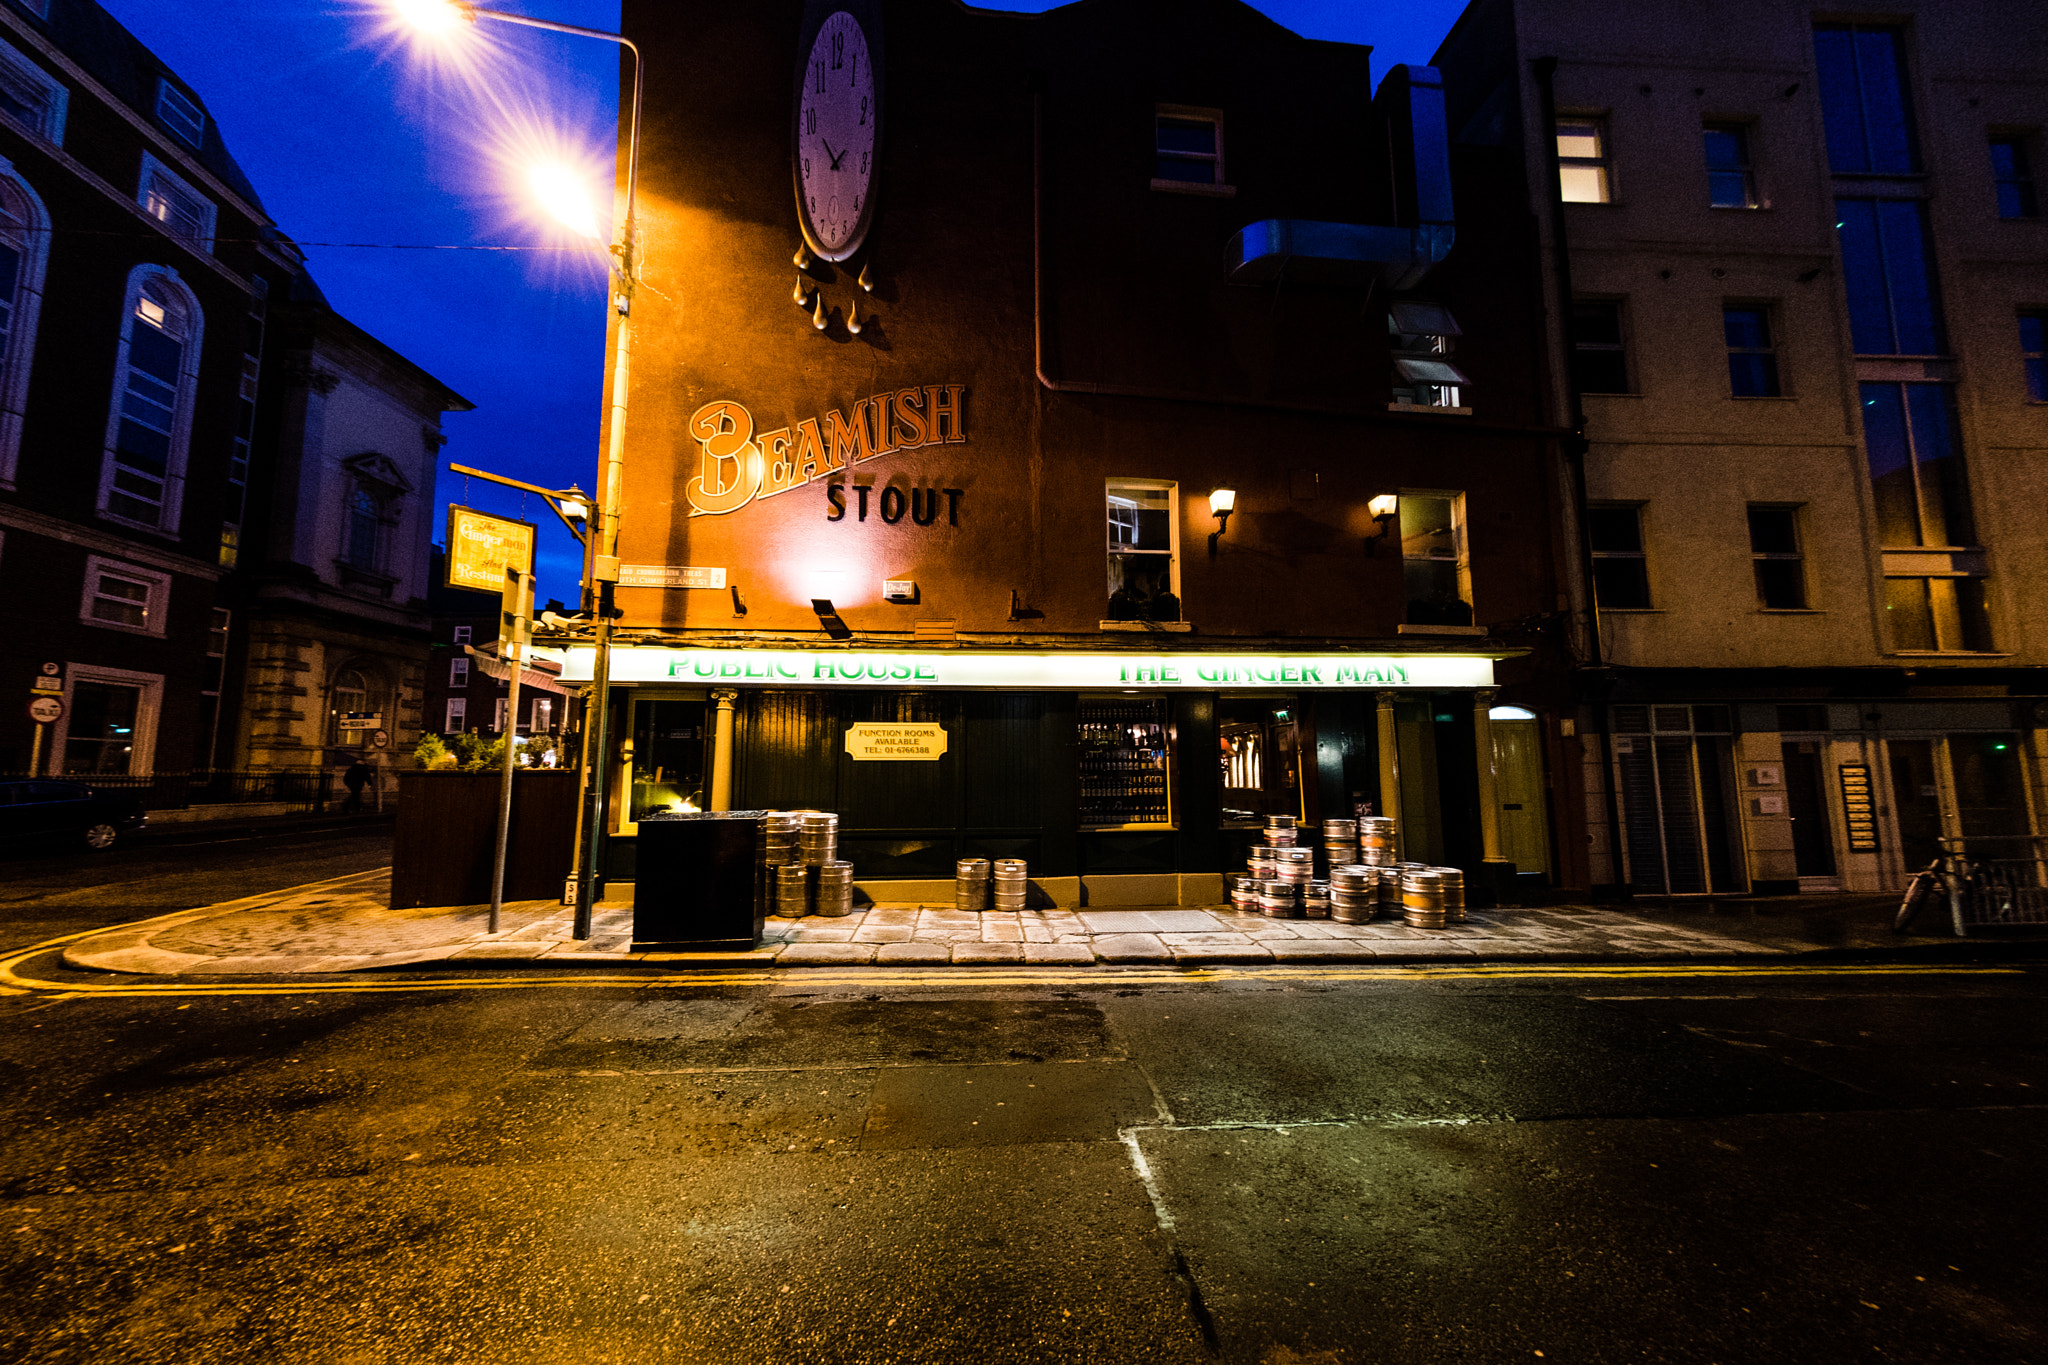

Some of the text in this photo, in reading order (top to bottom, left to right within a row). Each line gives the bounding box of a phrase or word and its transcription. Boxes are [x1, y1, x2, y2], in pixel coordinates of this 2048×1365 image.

[831, 31, 843, 70] 12
[816, 61, 826, 93] 11
[851, 53, 857, 87] 1
[806, 107, 816, 135] 10
[860, 95, 867, 125] 2
[804, 158, 810, 179] 9
[861, 151, 867, 174] 3
[811, 196, 816, 214] 8
[853, 194, 859, 211] 4
[820, 219, 825, 233] 7
[831, 227, 836, 242] 6
[842, 220, 847, 235] 5
[686, 384, 965, 517] BEAMISH
[827, 484, 965, 527] STOUT
[456, 563, 504, 583] Restaur
[640, 577, 694, 585] CUMBERLAND
[714, 573, 722, 584] 2
[667, 654, 939, 682] PUBLIC HOUSE
[1119, 660, 1410, 685] THE GINGER MAN
